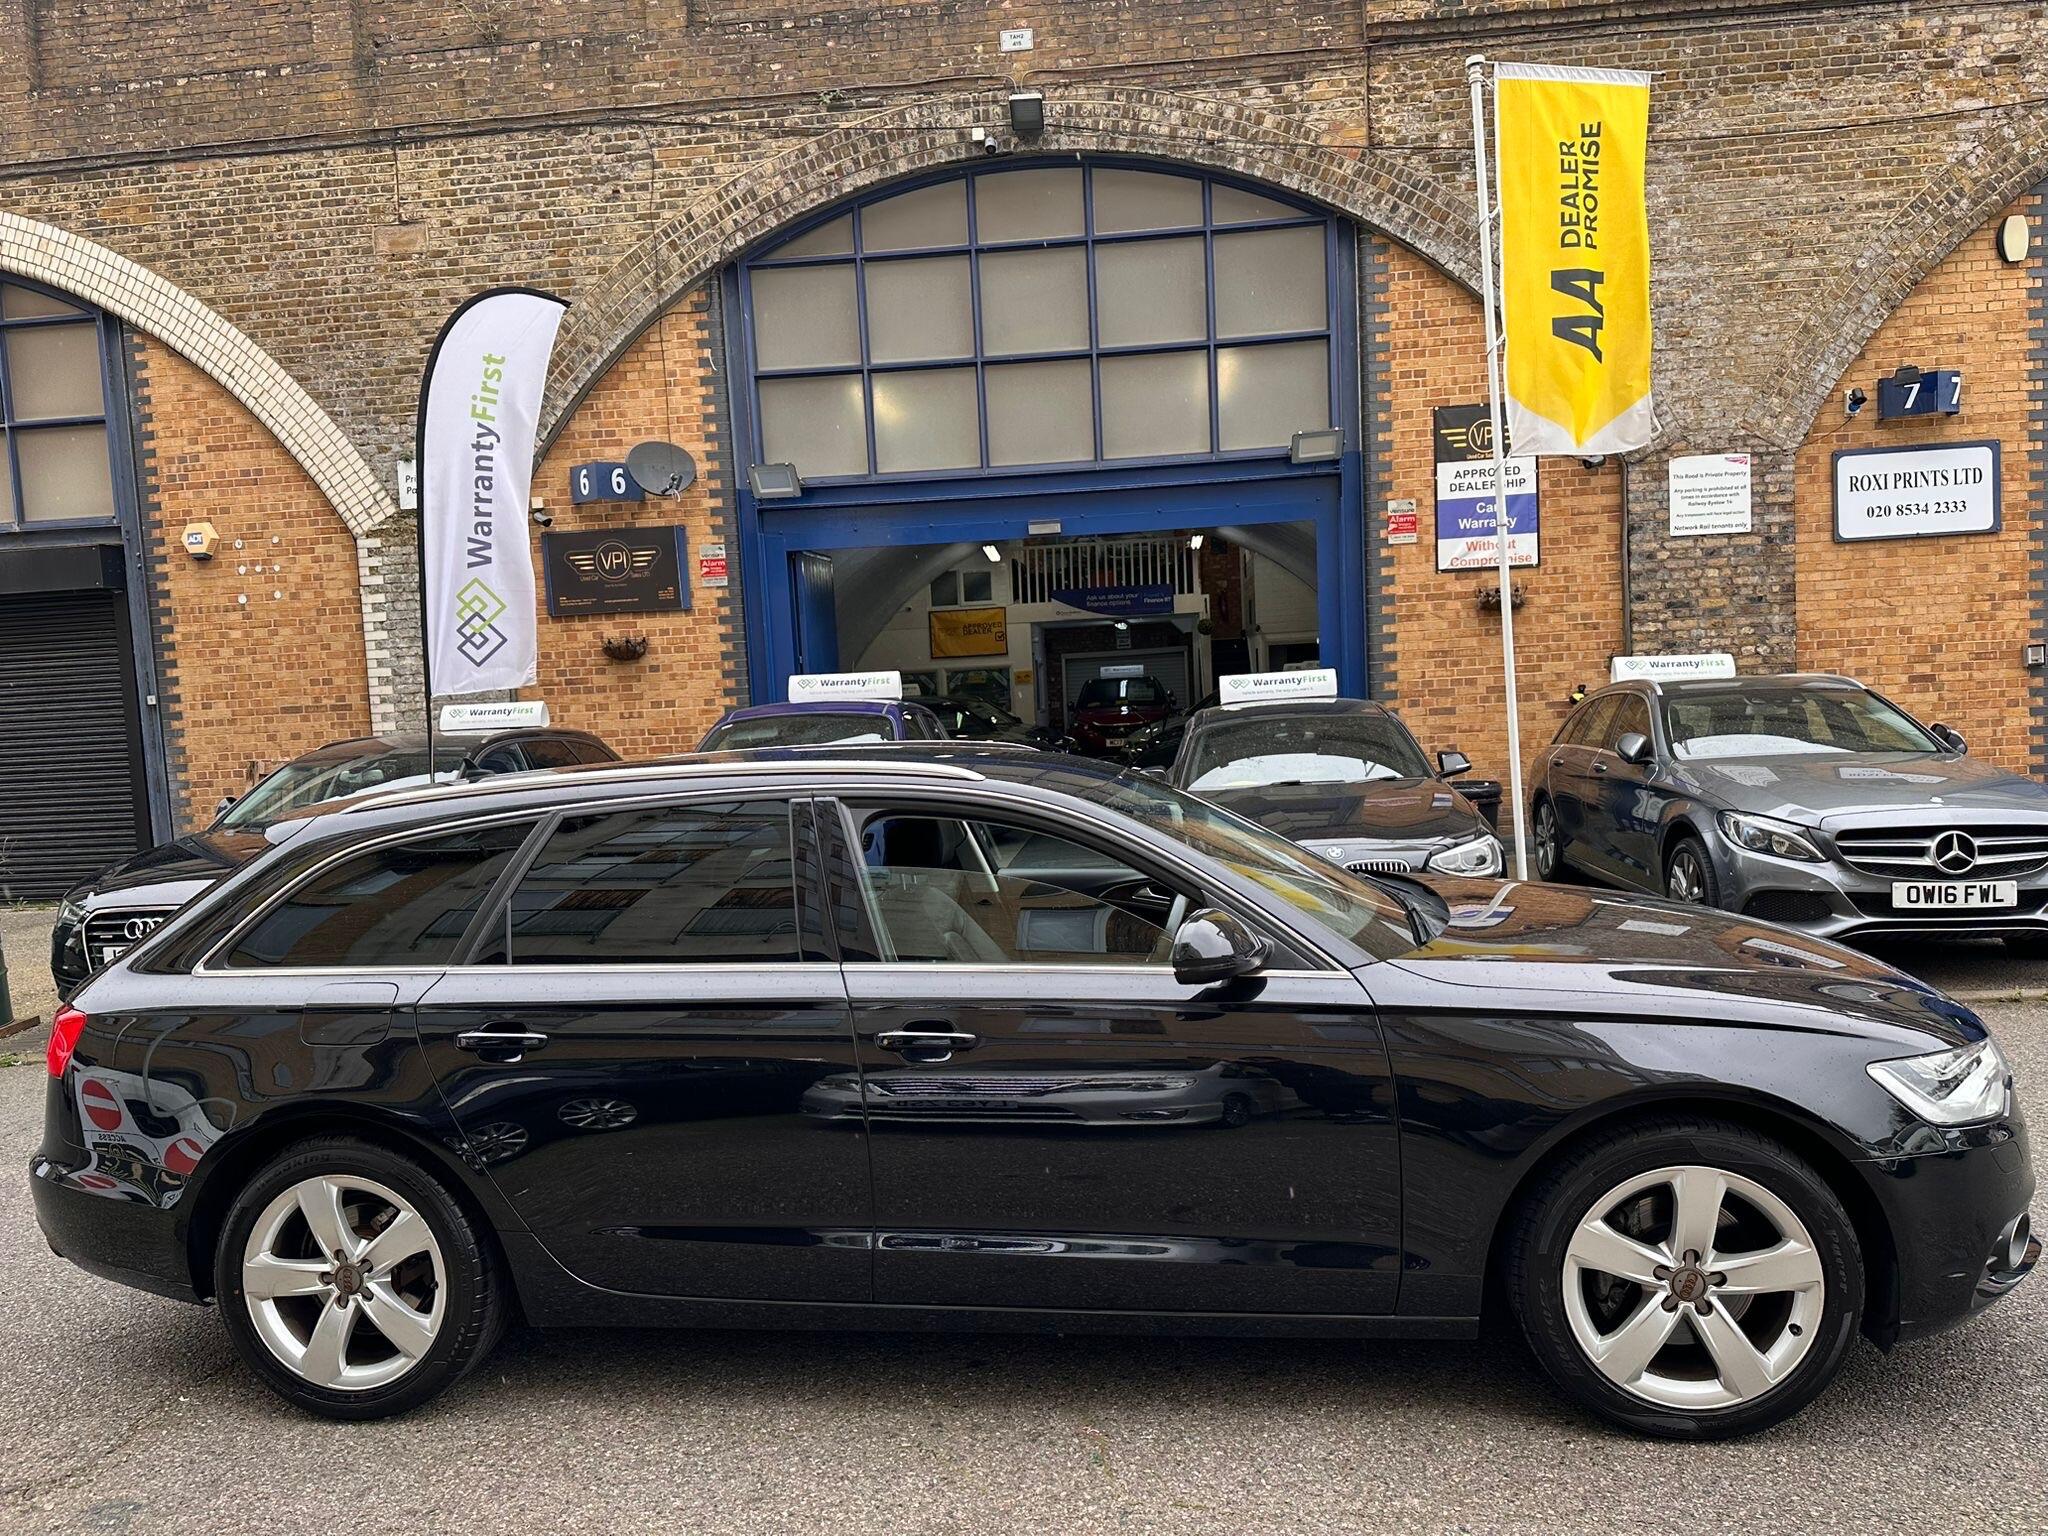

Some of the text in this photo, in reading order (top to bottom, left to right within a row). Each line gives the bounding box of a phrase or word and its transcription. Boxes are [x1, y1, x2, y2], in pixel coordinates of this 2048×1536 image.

[1559, 140, 1581, 248] DEALER
[1580, 121, 1602, 250] PROMISE
[1550, 268, 1605, 364] AA
[1903, 383, 1921, 409] 7
[1950, 376, 1961, 405] 7
[467, 352, 507, 569] WarrantyFirst
[579, 468, 590, 495] 6
[611, 467, 626, 494] 6
[1454, 466, 1521, 480] APPROED
[1849, 467, 1983, 493] ROXI PRINTS LTD
[1449, 478, 1526, 492] DEALERHIP
[1866, 500, 1967, 518] 020 8534 2333
[1458, 516, 1517, 530] Warraty
[188, 534, 202, 543] ADT
[599, 551, 627, 570] VPI
[962, 622, 1002, 630] APPROVED
[963, 627, 993, 636] DEALER
[1649, 658, 1726, 669] WarrantyFirst
[820, 677, 891, 687] WarrantyFirst
[1253, 674, 1328, 686] WarrantyFirst
[469, 706, 534, 717] WarrantyFirst
[1906, 884, 2005, 904] OW16 FWL
